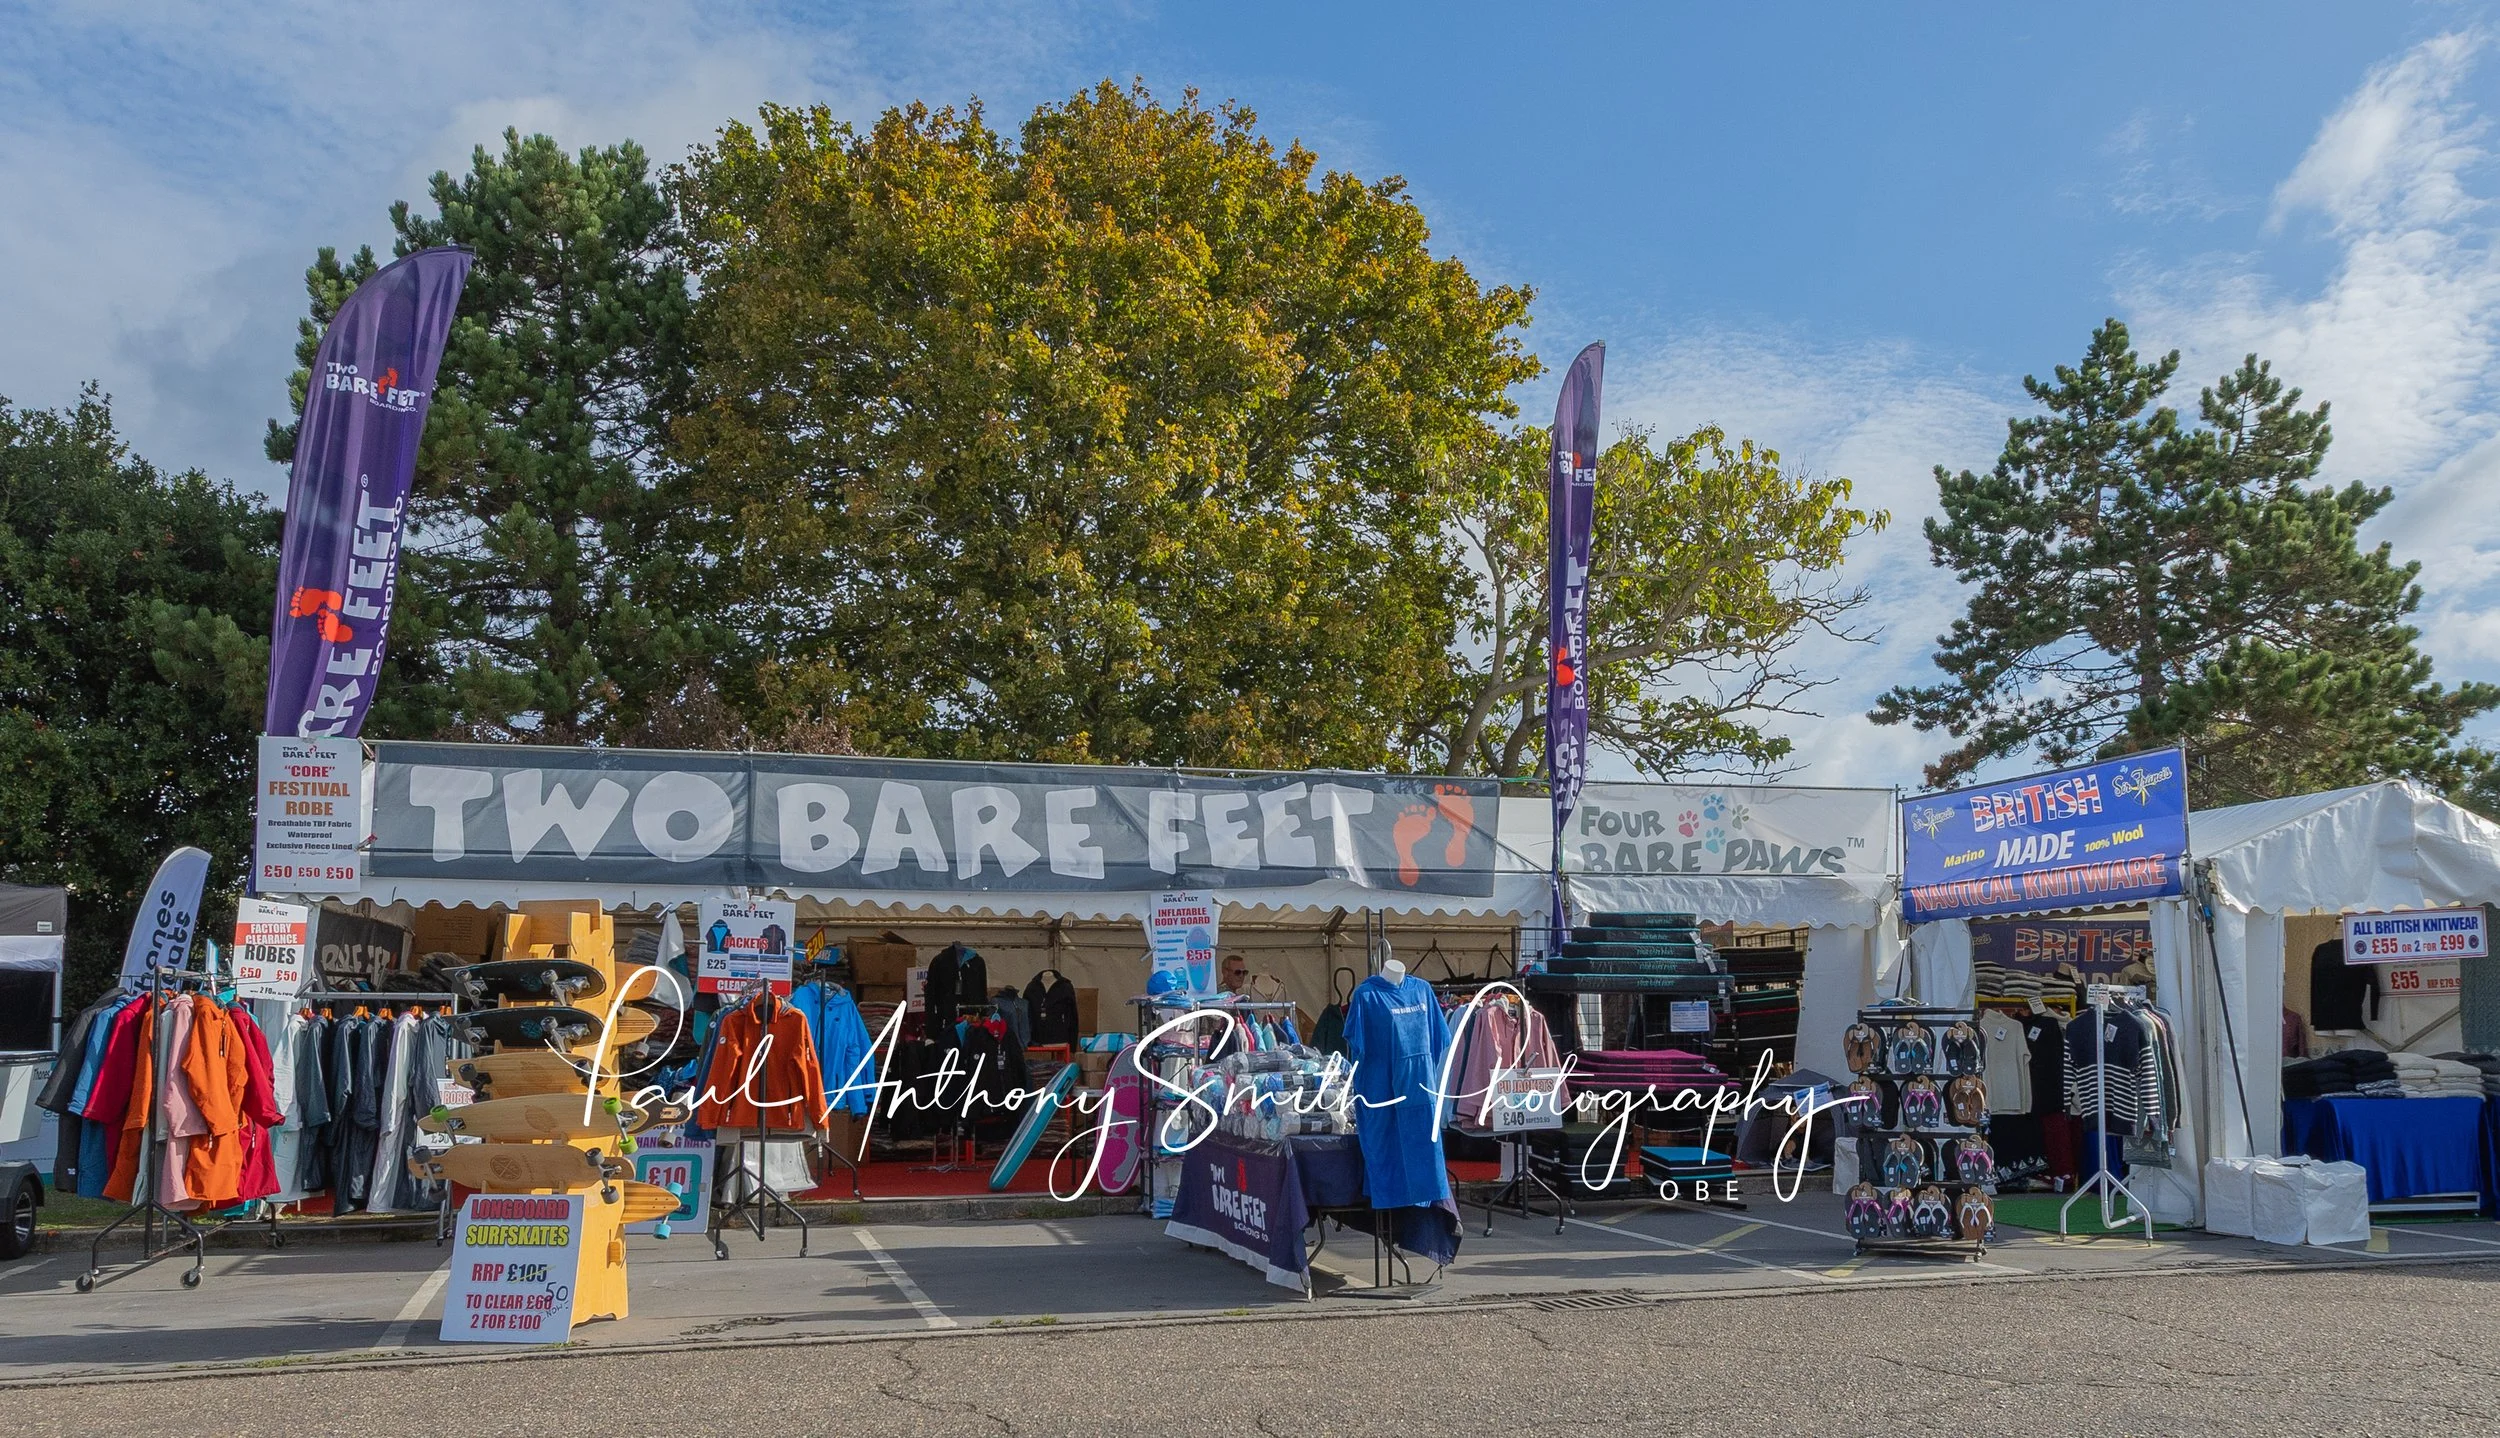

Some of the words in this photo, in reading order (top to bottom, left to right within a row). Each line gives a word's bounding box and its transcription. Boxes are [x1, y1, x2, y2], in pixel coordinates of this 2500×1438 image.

[327, 361, 358, 375] TWO
[326, 373, 378, 400] BARE
[343, 489, 396, 620] FEET
[282, 751, 311, 759] BARE
[2130, 766, 2173, 791] Francis
[269, 781, 350, 797] FESTIVAL
[285, 801, 333, 816] ROBE
[1970, 773, 2103, 833] BRITISH
[268, 819, 312, 828] Breathable
[313, 819, 326, 827] TBF
[328, 820, 352, 828] Fabric
[410, 766, 735, 863] TWO
[776, 781, 1104, 880] BARE
[1148, 781, 1374, 888] FEET
[1580, 806, 1665, 838] FOUR
[287, 831, 333, 839] Waterproof
[266, 842, 303, 850] Exclusive
[1943, 848, 1985, 869] Marino
[1993, 830, 2076, 869] MADE
[2084, 837, 2110, 853] 100%
[2112, 824, 2144, 846] Wool
[1580, 841, 1702, 874] BARE
[1722, 838, 1847, 874] PAWS
[1846, 837, 1865, 848] TM
[263, 865, 293, 878] £50
[298, 866, 320, 878] £50
[326, 867, 354, 880] £50
[1911, 874, 2021, 913] NAUTICAL
[2025, 853, 2167, 899] KNITWARE
[722, 909, 750, 918] BARE
[754, 910, 775, 919] FEET
[1158, 907, 1207, 917] INFLATABLE
[250, 923, 292, 934] FACTORY
[1154, 917, 1179, 926] BODY
[1180, 916, 1210, 925] BOARD
[2353, 921, 2373, 936] ALL
[2375, 918, 2420, 935] BRITISH
[2423, 916, 2479, 933] KNITWEAR
[245, 933, 298, 945] CLEARANCE
[724, 937, 769, 950] JACKETS
[2014, 928, 2154, 962] BRITISH
[2371, 937, 2398, 955] £55
[2401, 944, 2412, 953] OR
[2414, 940, 2421, 952] 2
[2423, 943, 2437, 952] FOR
[2440, 934, 2465, 951] £99
[244, 943, 296, 965] ROBES
[1186, 949, 1212, 961] £55
[707, 959, 727, 970] £25
[240, 966, 262, 979] £50
[276, 969, 298, 982] £50
[2391, 970, 2420, 990] £55
[1497, 1080, 1511, 1094] PU
[1512, 1079, 1554, 1094] JACKETS
[648, 1166, 687, 1186] £10
[471, 1199, 570, 1220] LONGBOARD
[465, 1224, 570, 1246] SURFSKATES
[471, 1264, 504, 1281] RRP
[507, 1263, 547, 1282] £105
[545, 1282, 569, 1302] 50
[466, 1294, 482, 1309] TO
[485, 1294, 523, 1309] CLEAR
[470, 1314, 478, 1329] 2
[481, 1314, 506, 1329] FOR
[508, 1314, 542, 1330] £100
